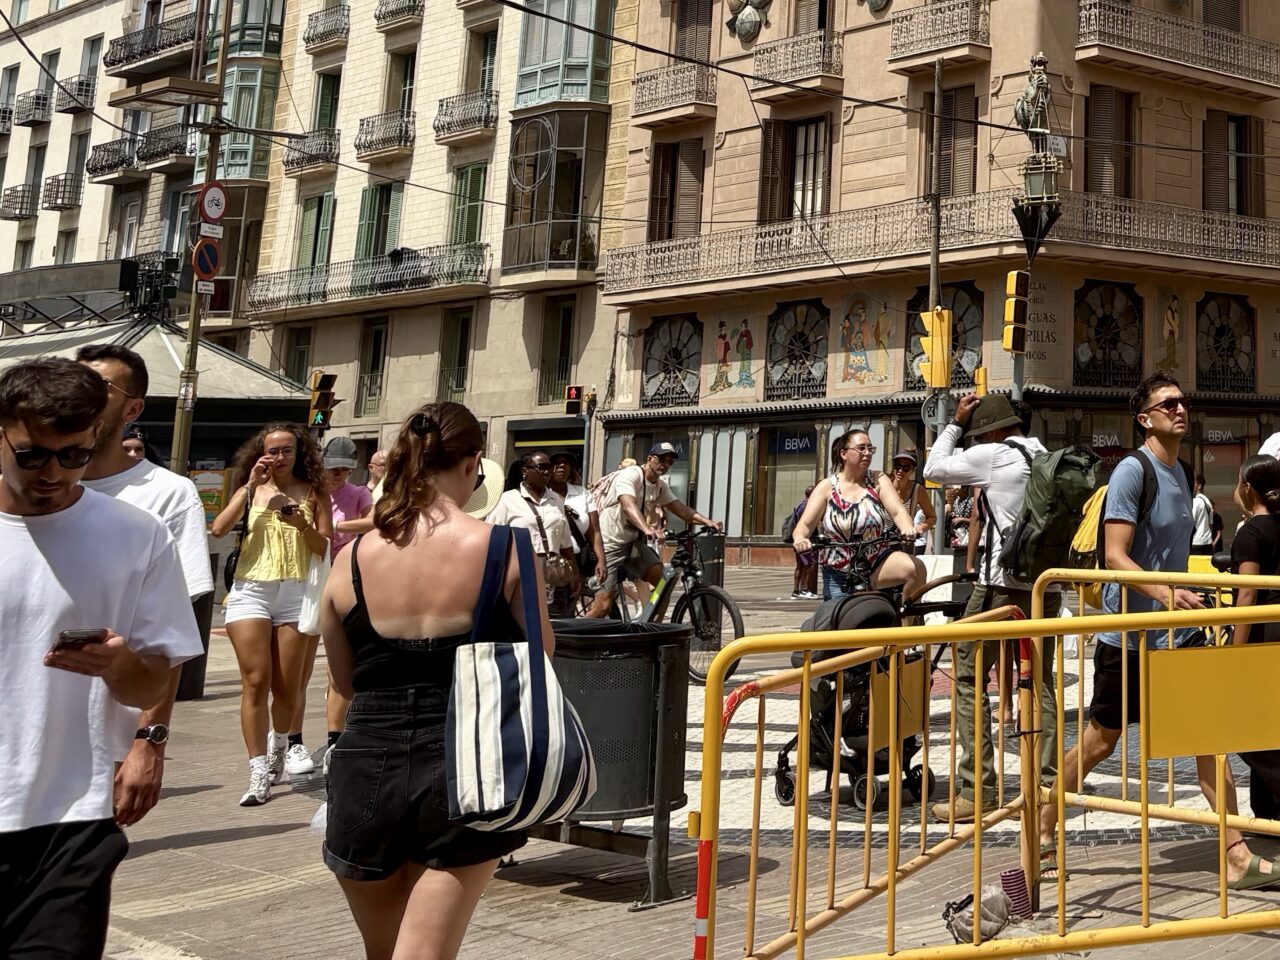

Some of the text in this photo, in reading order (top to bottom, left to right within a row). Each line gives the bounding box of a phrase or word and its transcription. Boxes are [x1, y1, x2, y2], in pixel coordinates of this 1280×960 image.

[1028, 312, 1057, 324] GUAS
[1025, 330, 1057, 343] RILLAS
[1092, 434, 1120, 448] BBVA
[1208, 429, 1234, 442] BBVA
[784, 437, 811, 450] BBVA
